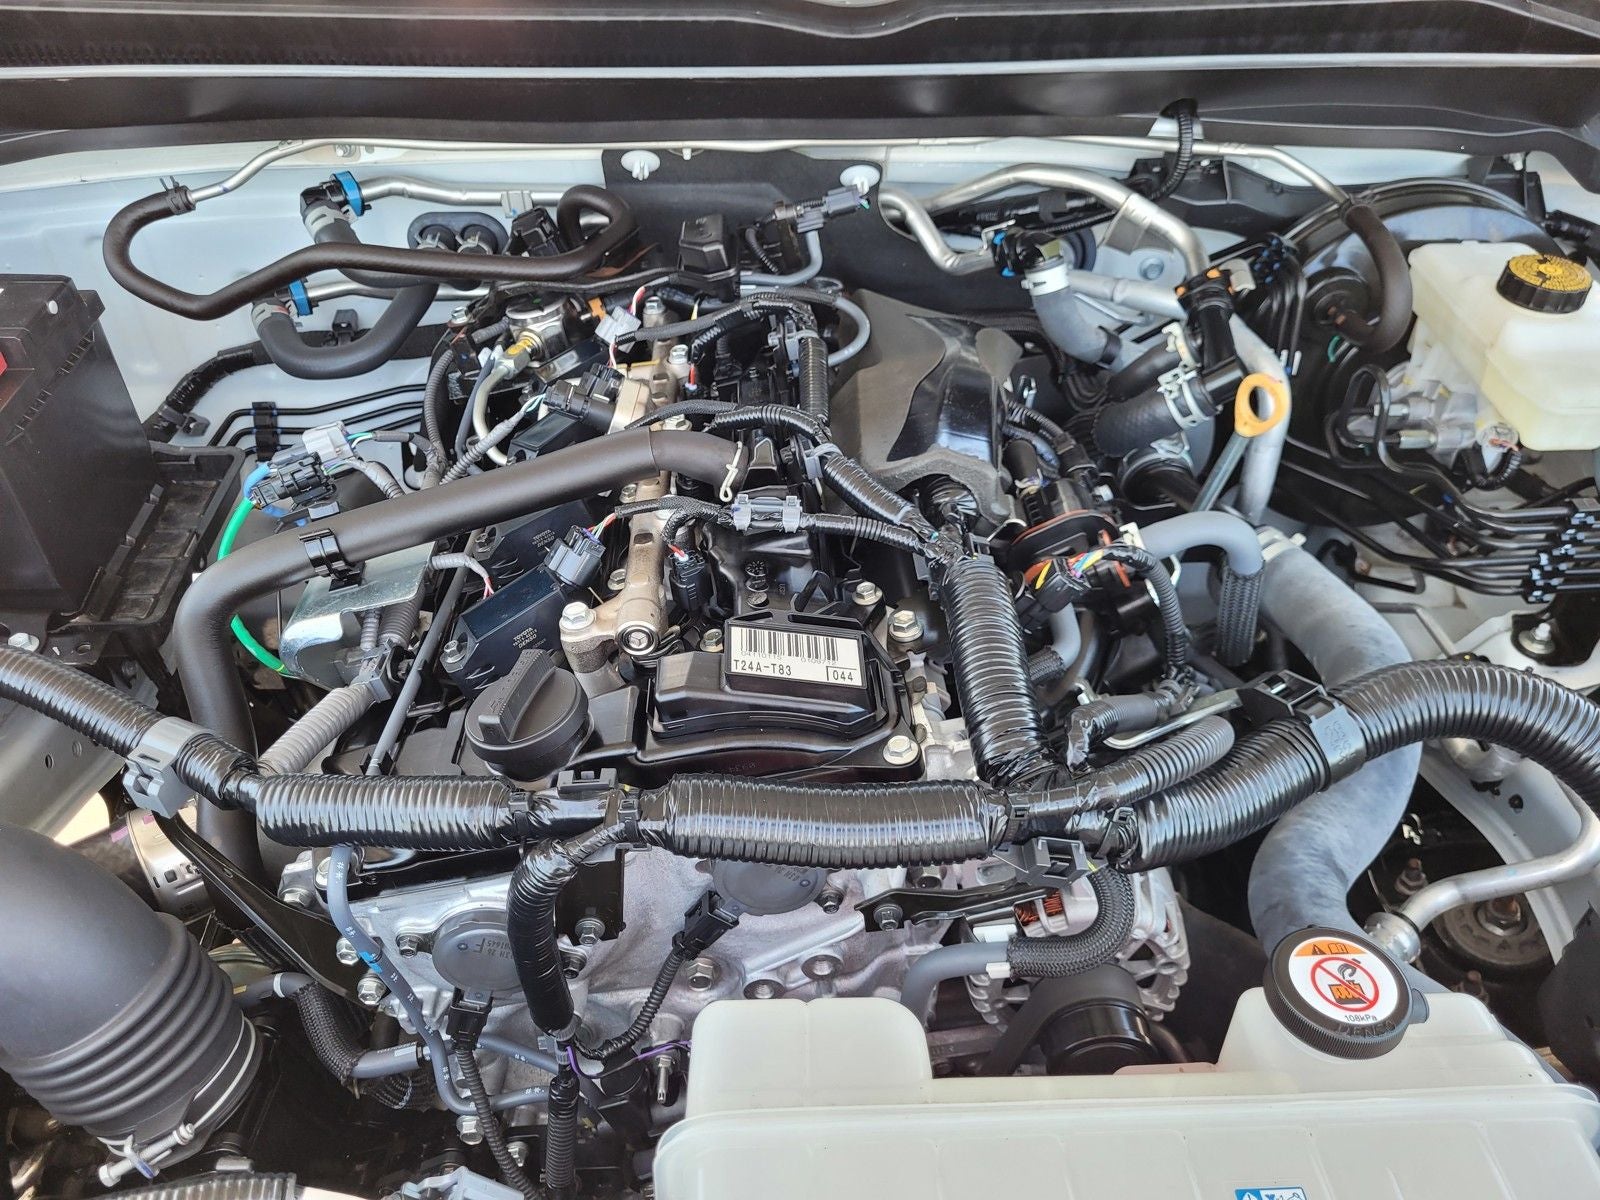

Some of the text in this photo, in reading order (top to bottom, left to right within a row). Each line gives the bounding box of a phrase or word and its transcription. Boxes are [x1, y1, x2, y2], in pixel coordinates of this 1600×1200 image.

[533, 529, 551, 540] TOYOTA
[513, 627, 533, 640] TOYOTA
[518, 633, 537, 648] DENSO
[733, 659, 854, 681] T24A-T83 044
[1344, 1013, 1378, 1022] 108kPa
